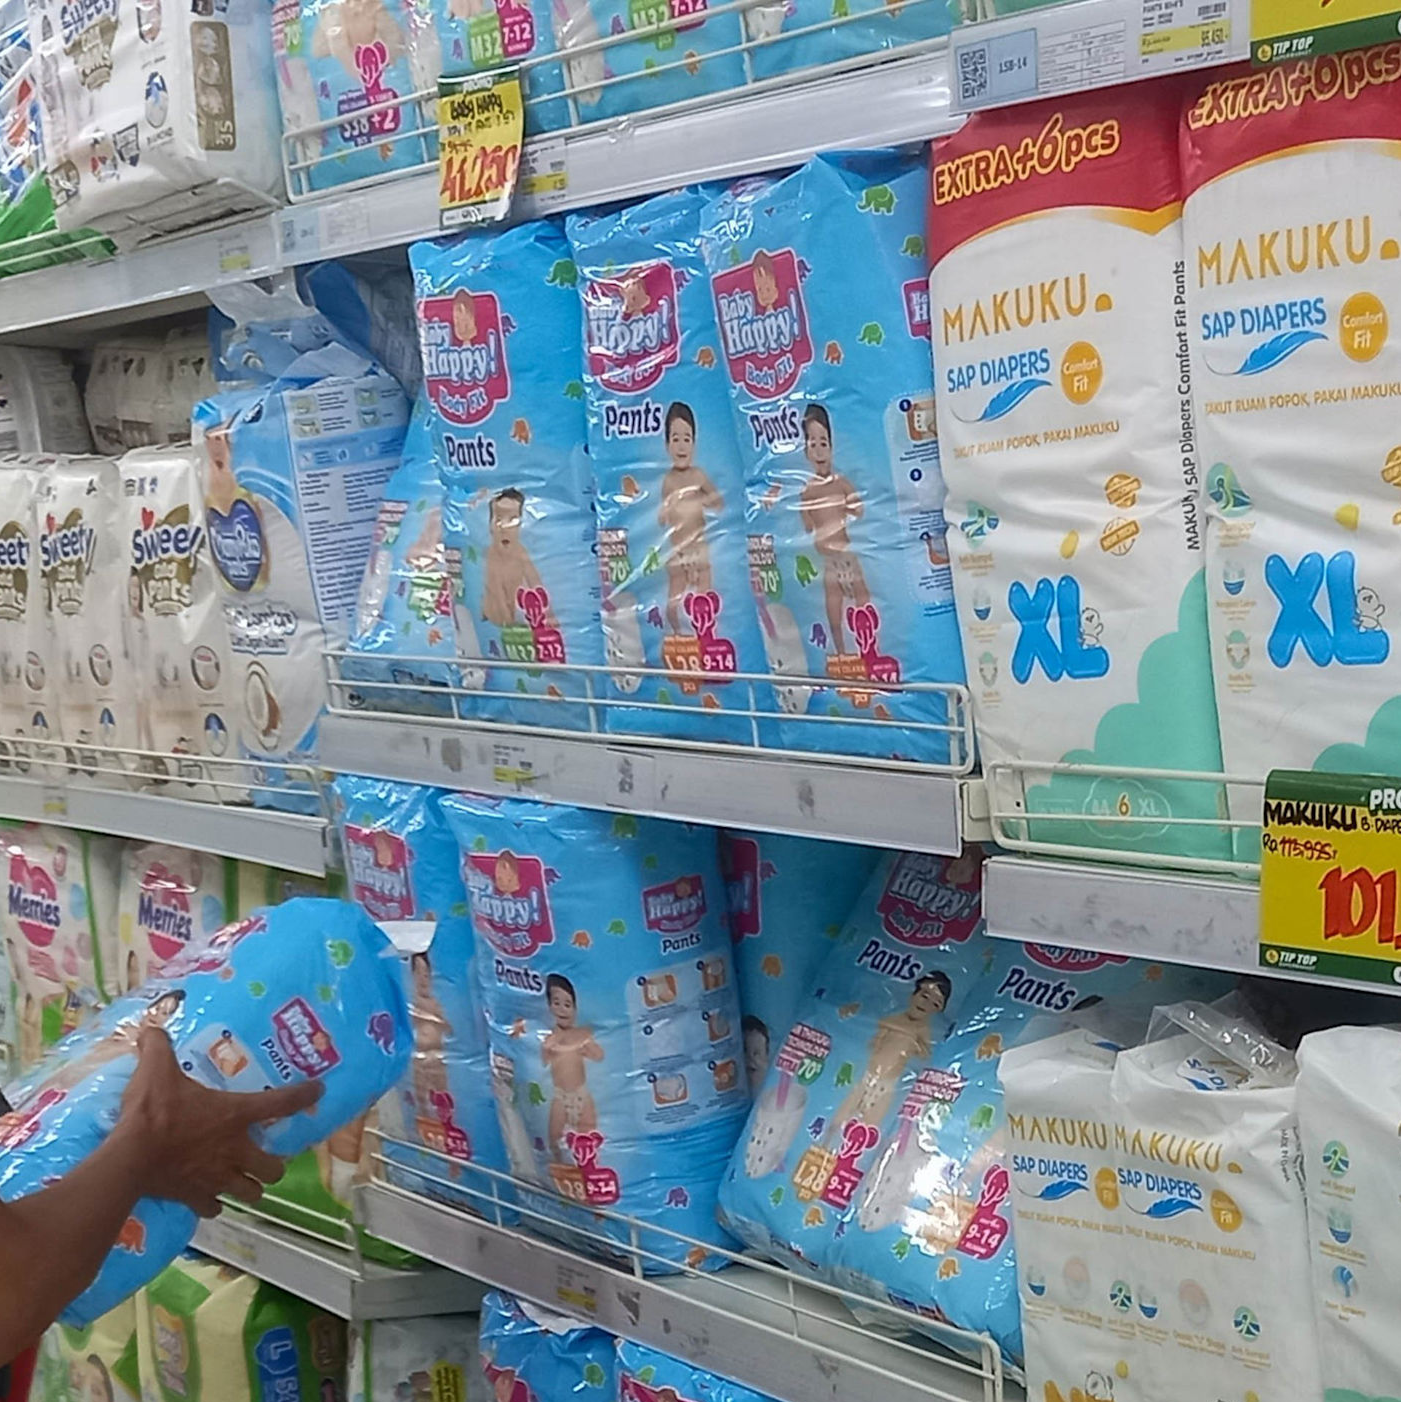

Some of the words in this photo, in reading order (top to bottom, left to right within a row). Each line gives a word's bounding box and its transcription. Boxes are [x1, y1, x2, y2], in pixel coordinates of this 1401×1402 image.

[1271, 38, 1290, 53] TIP
[1291, 35, 1315, 50] TOP
[1199, 216, 1370, 288] MAKUKU
[724, 303, 799, 358] Happy!
[944, 272, 1087, 346] MAKUKU
[603, 401, 662, 437] Pants
[750, 407, 800, 445] Pants
[446, 433, 495, 468] Pants
[1007, 573, 1111, 685] XL
[1265, 549, 1391, 669] XL
[703, 652, 735, 671] 9-14
[1263, 800, 1358, 833] MAKUKU
[8, 883, 62, 929] Merries
[138, 893, 194, 941] Merries
[856, 938, 922, 984] Pants
[1008, 1112, 1107, 1151] MAKUKU
